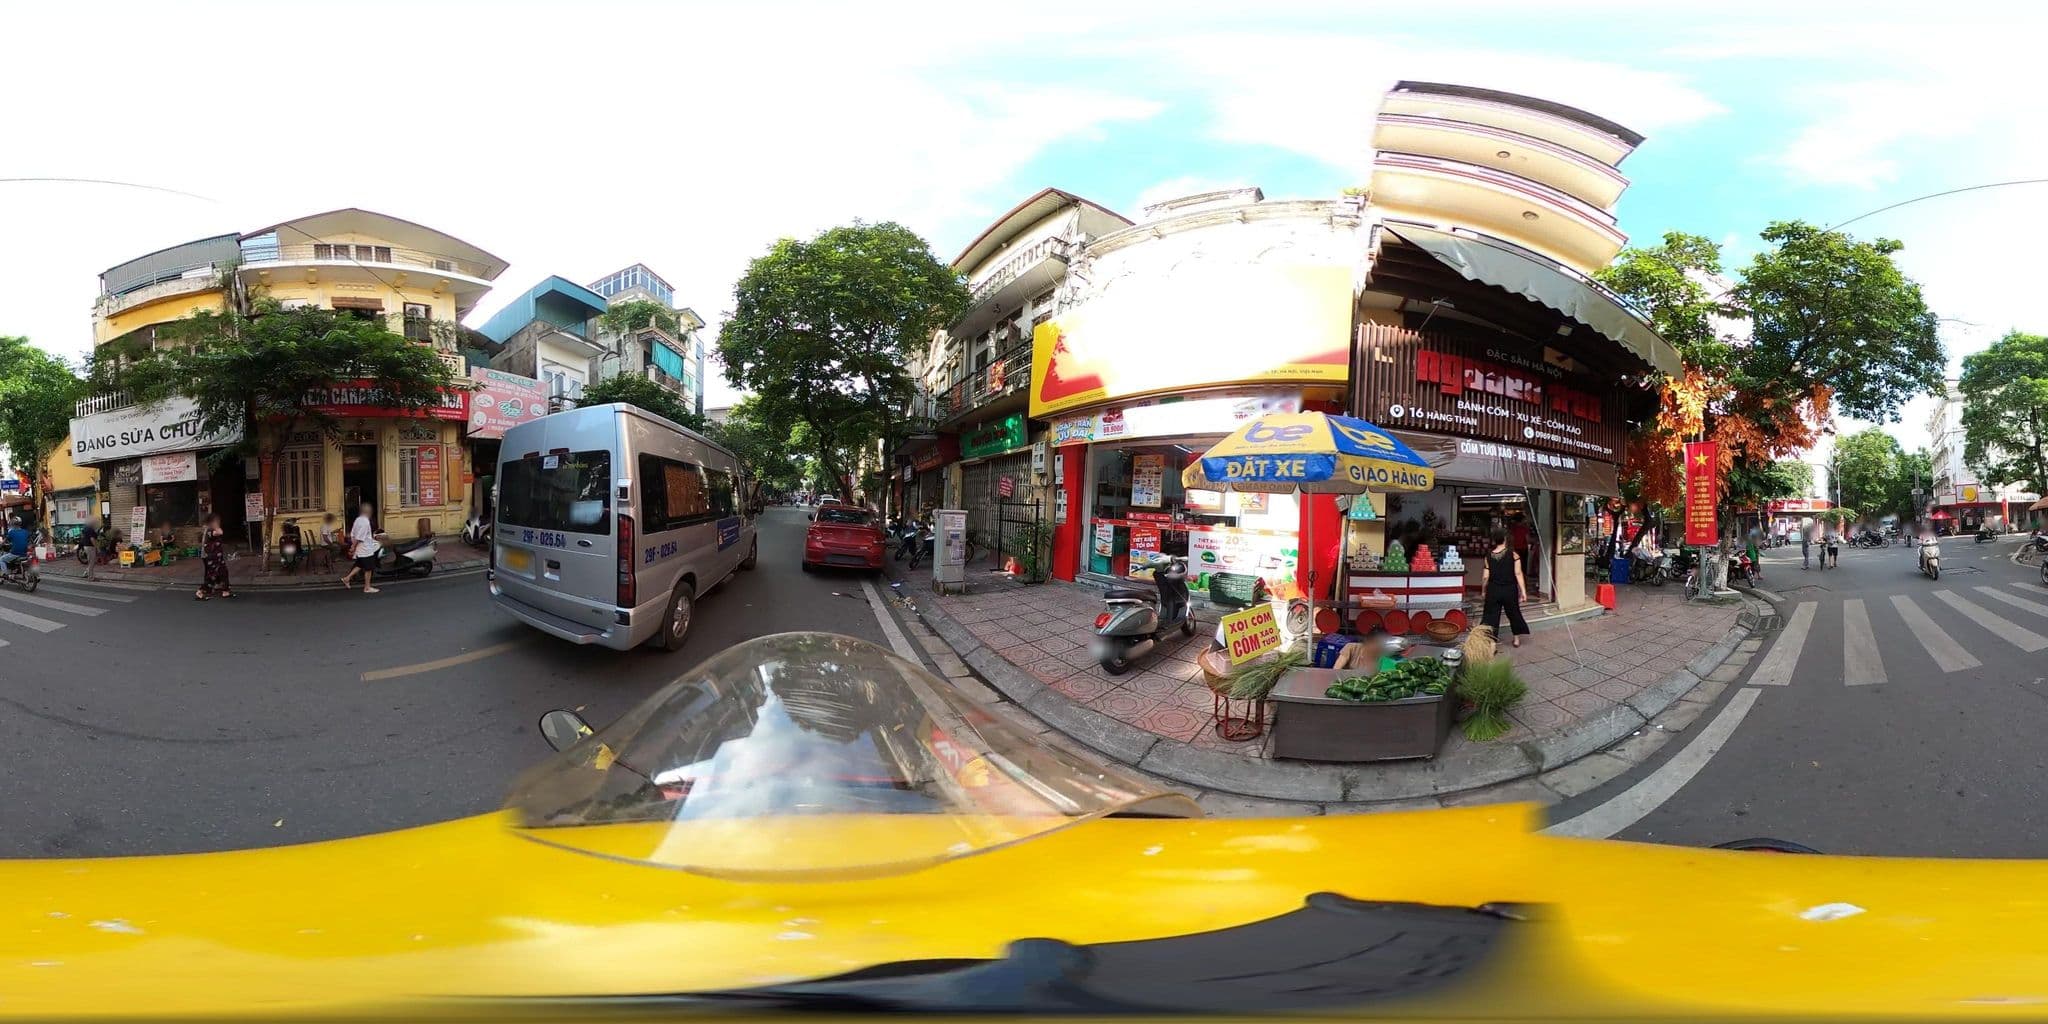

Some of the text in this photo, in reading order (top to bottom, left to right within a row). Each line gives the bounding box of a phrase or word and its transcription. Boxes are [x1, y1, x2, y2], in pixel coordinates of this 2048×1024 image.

[1409, 407, 1477, 426] 16 HÀNG THAN
[77, 435, 116, 453] ĐANG
[121, 427, 154, 445] SỬA
[1245, 421, 1313, 443] be
[1328, 418, 1396, 451] be
[1226, 456, 1306, 482] ĐẶT XE
[1349, 465, 1427, 487] GIAO HÀNG
[522, 530, 535, 545] 29F
